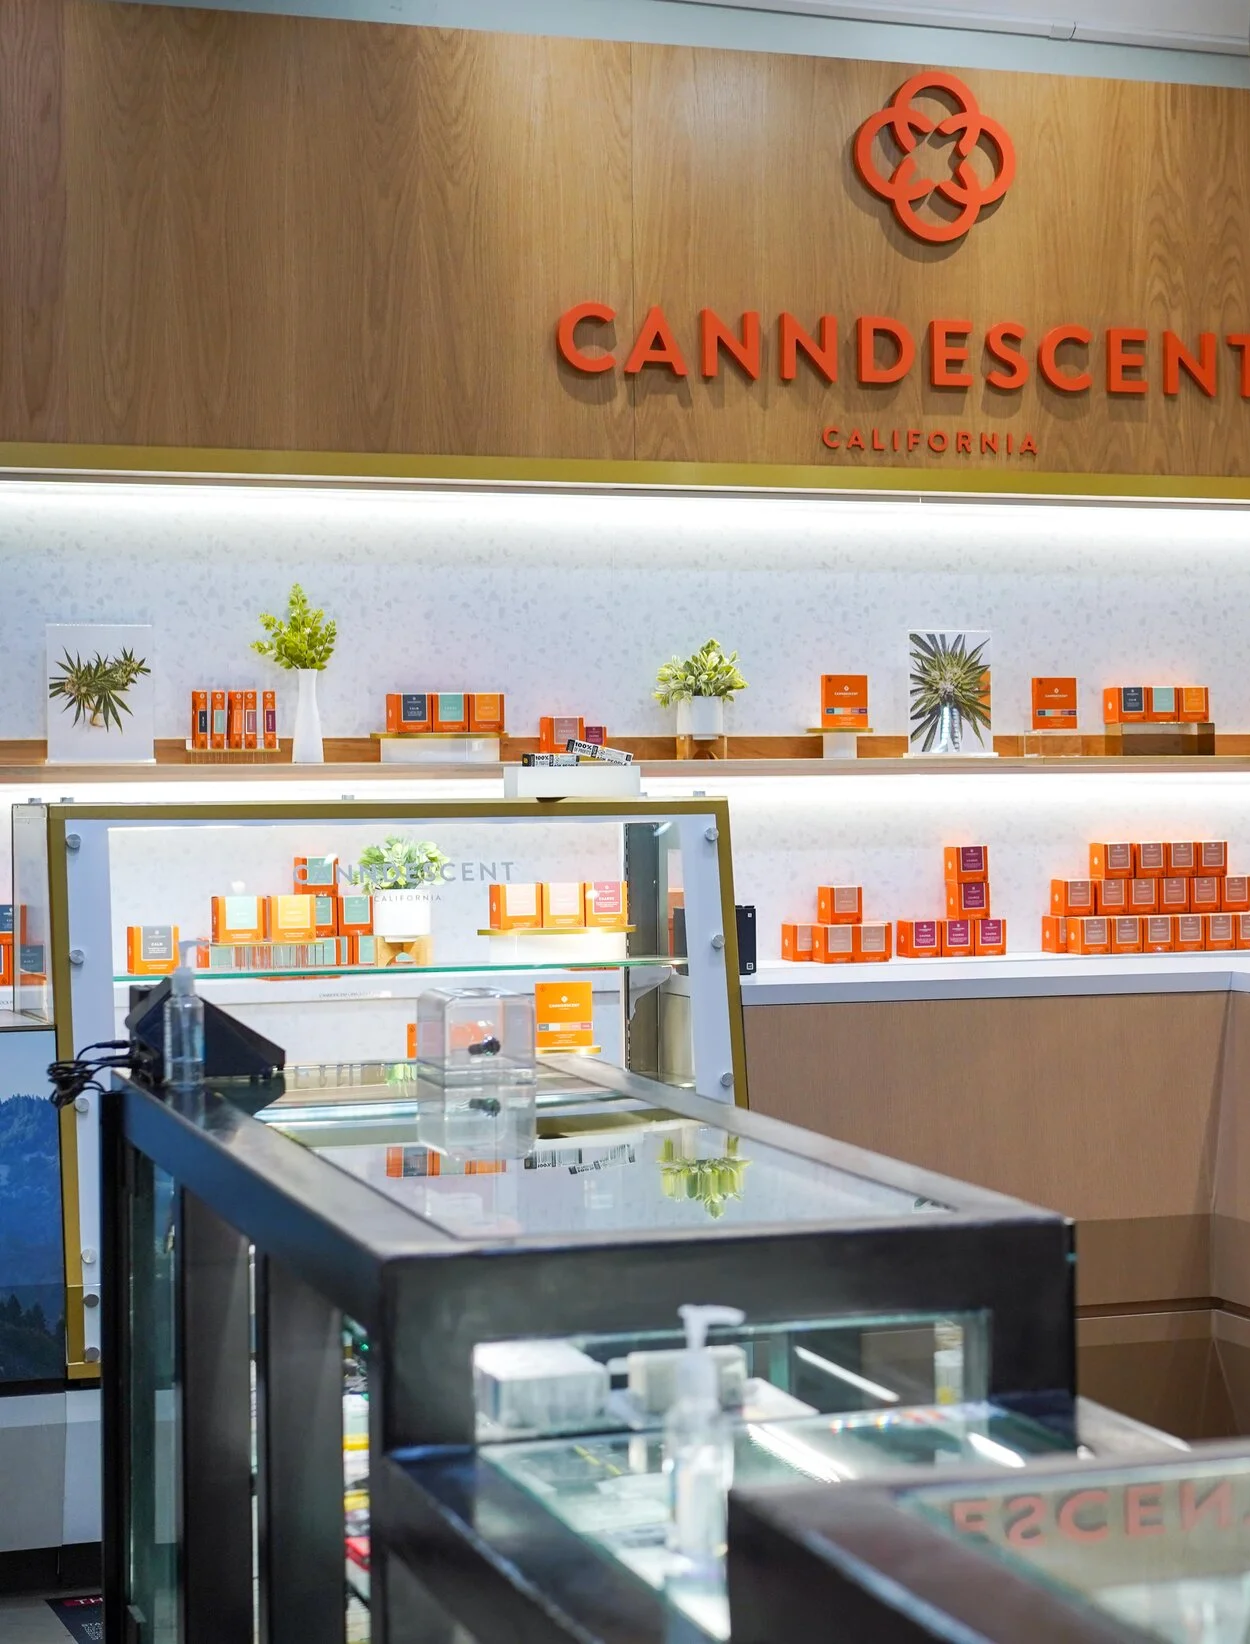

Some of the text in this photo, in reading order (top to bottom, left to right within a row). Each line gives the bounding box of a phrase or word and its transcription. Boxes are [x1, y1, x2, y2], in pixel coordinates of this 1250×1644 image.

[822, 426, 1039, 456] CALIFORNIA
[293, 862, 514, 884] CANNDESCENT
[374, 894, 442, 903] CALIFORNIA
